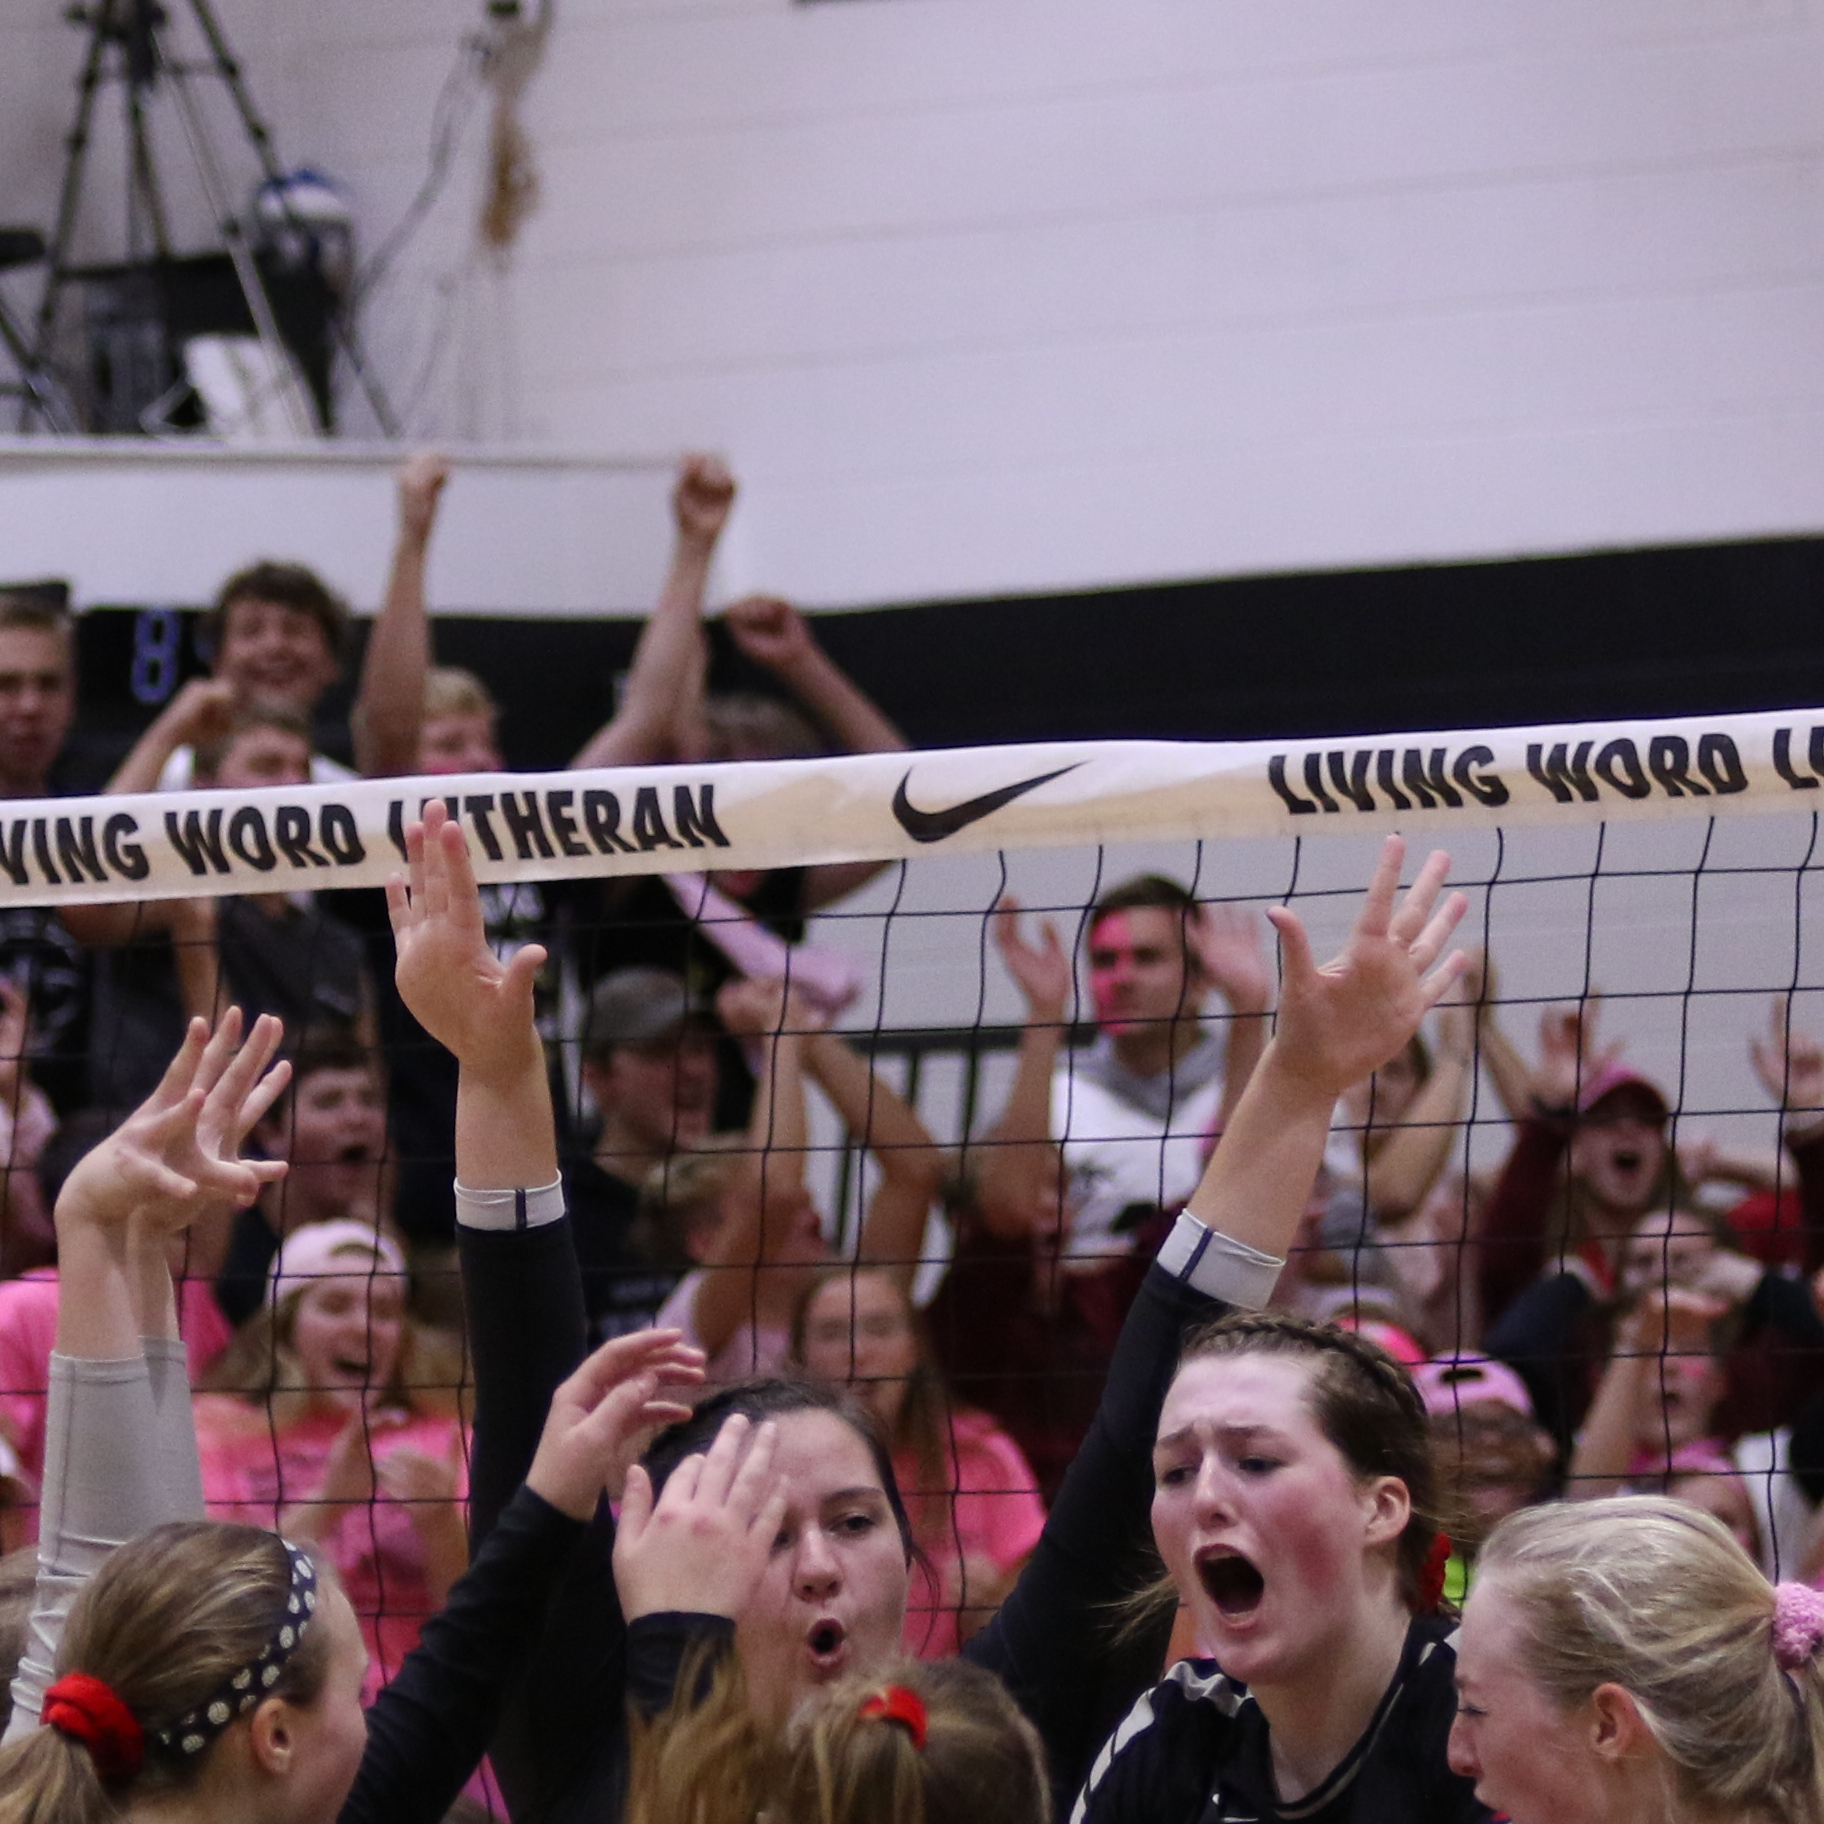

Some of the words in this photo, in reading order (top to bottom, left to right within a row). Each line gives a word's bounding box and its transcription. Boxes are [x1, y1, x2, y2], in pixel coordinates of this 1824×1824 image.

[1269, 745, 1510, 815] LIVING
[1526, 733, 1749, 804] WORD
[165, 804, 367, 876] WORD
[388, 784, 731, 864] LTHERAN
